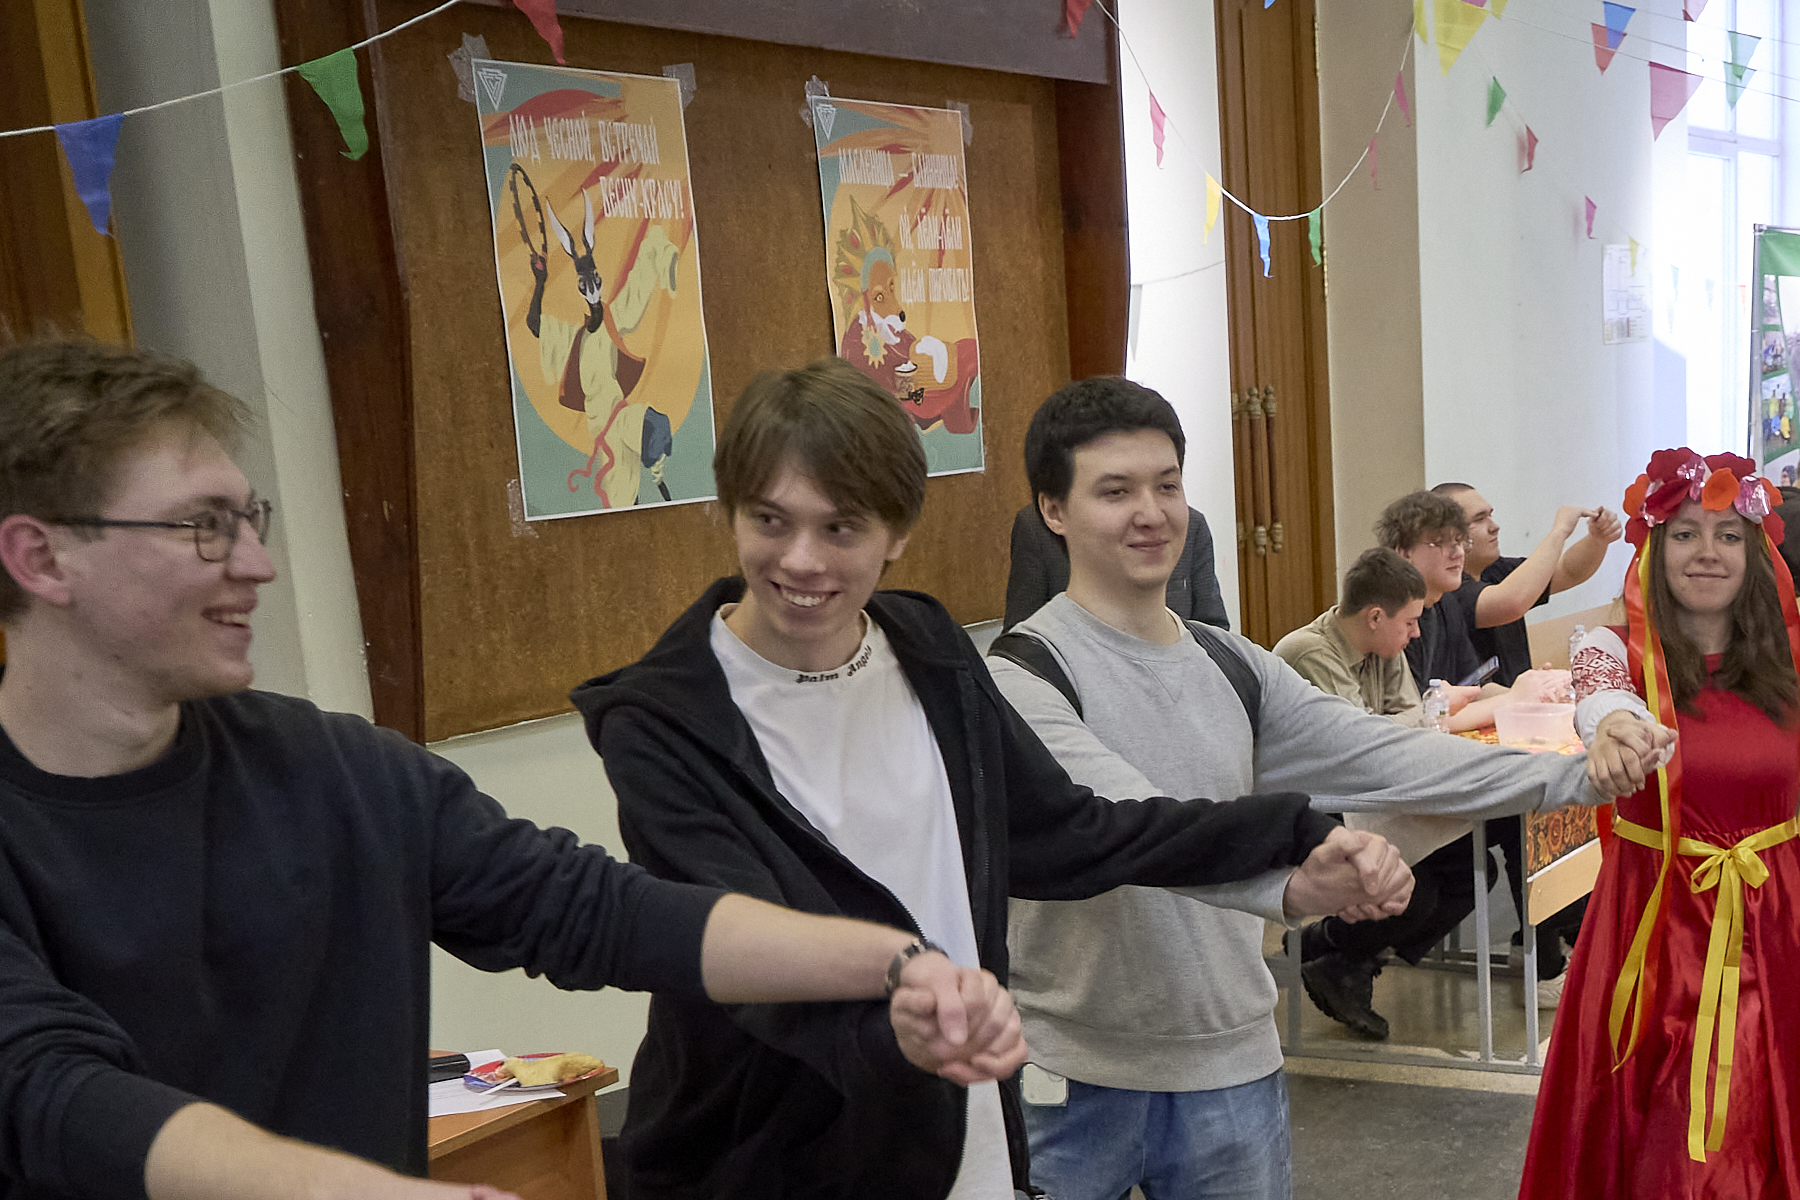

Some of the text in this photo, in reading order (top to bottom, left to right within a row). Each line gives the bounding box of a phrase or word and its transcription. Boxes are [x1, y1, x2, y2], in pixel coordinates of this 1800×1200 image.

[508, 114, 540, 165] ЛЮД
[599, 117, 659, 164] ВСТРЕЧАЙ
[838, 148, 894, 188] МАСЛЕНИЦА
[599, 176, 685, 219] ВЕСНУ-КРАСУ!
[796, 673, 839, 683] Palm
